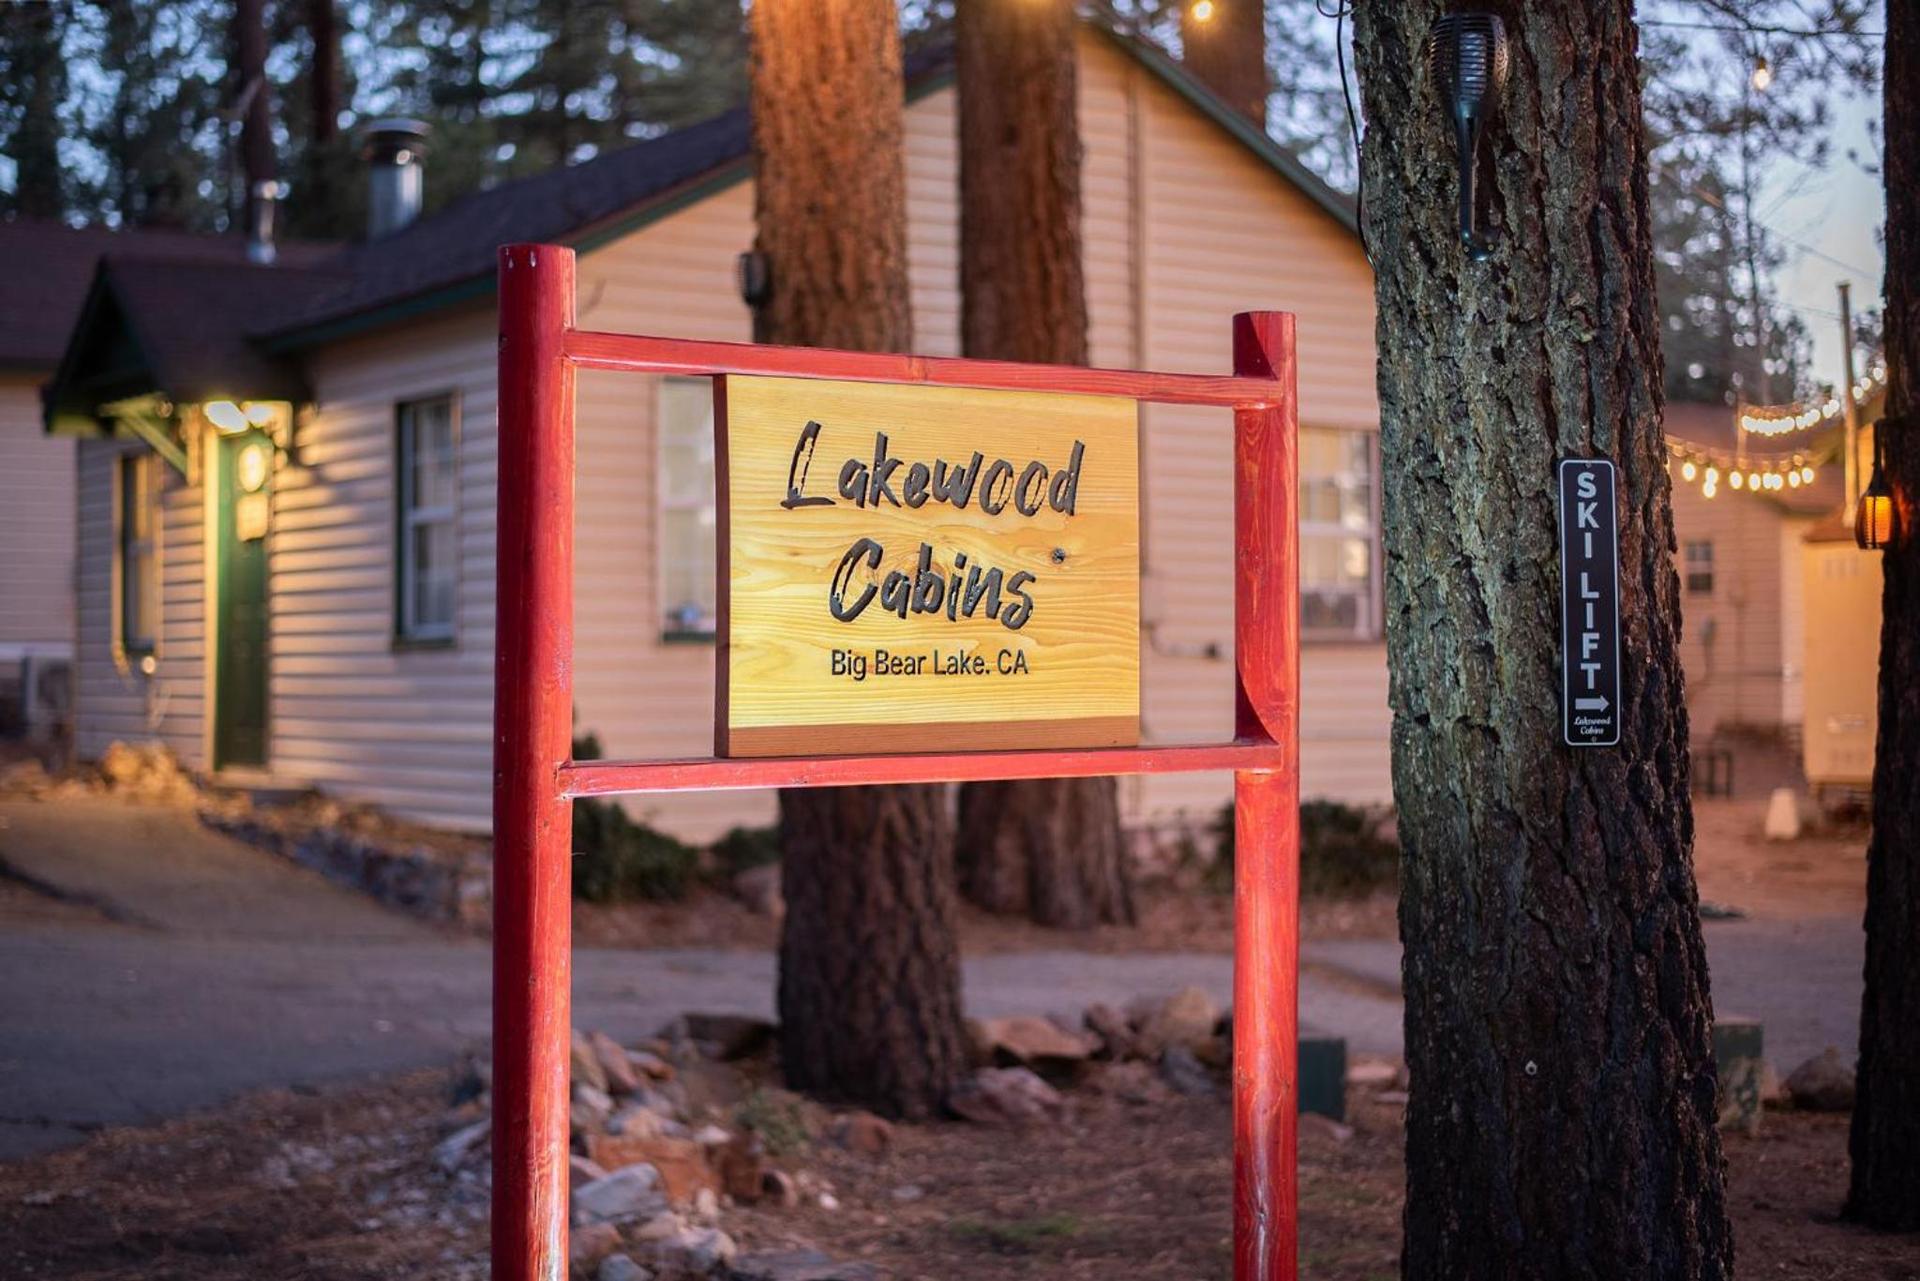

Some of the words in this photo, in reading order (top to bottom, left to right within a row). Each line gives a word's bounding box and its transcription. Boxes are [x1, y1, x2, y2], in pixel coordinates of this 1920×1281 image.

[780, 420, 1086, 517] Lakewood
[829, 537, 1037, 630] Cabins
[1580, 572, 1600, 689] LIFT
[831, 649, 867, 681] Big
[875, 649, 926, 676] Bear
[998, 649, 1029, 675] CA
